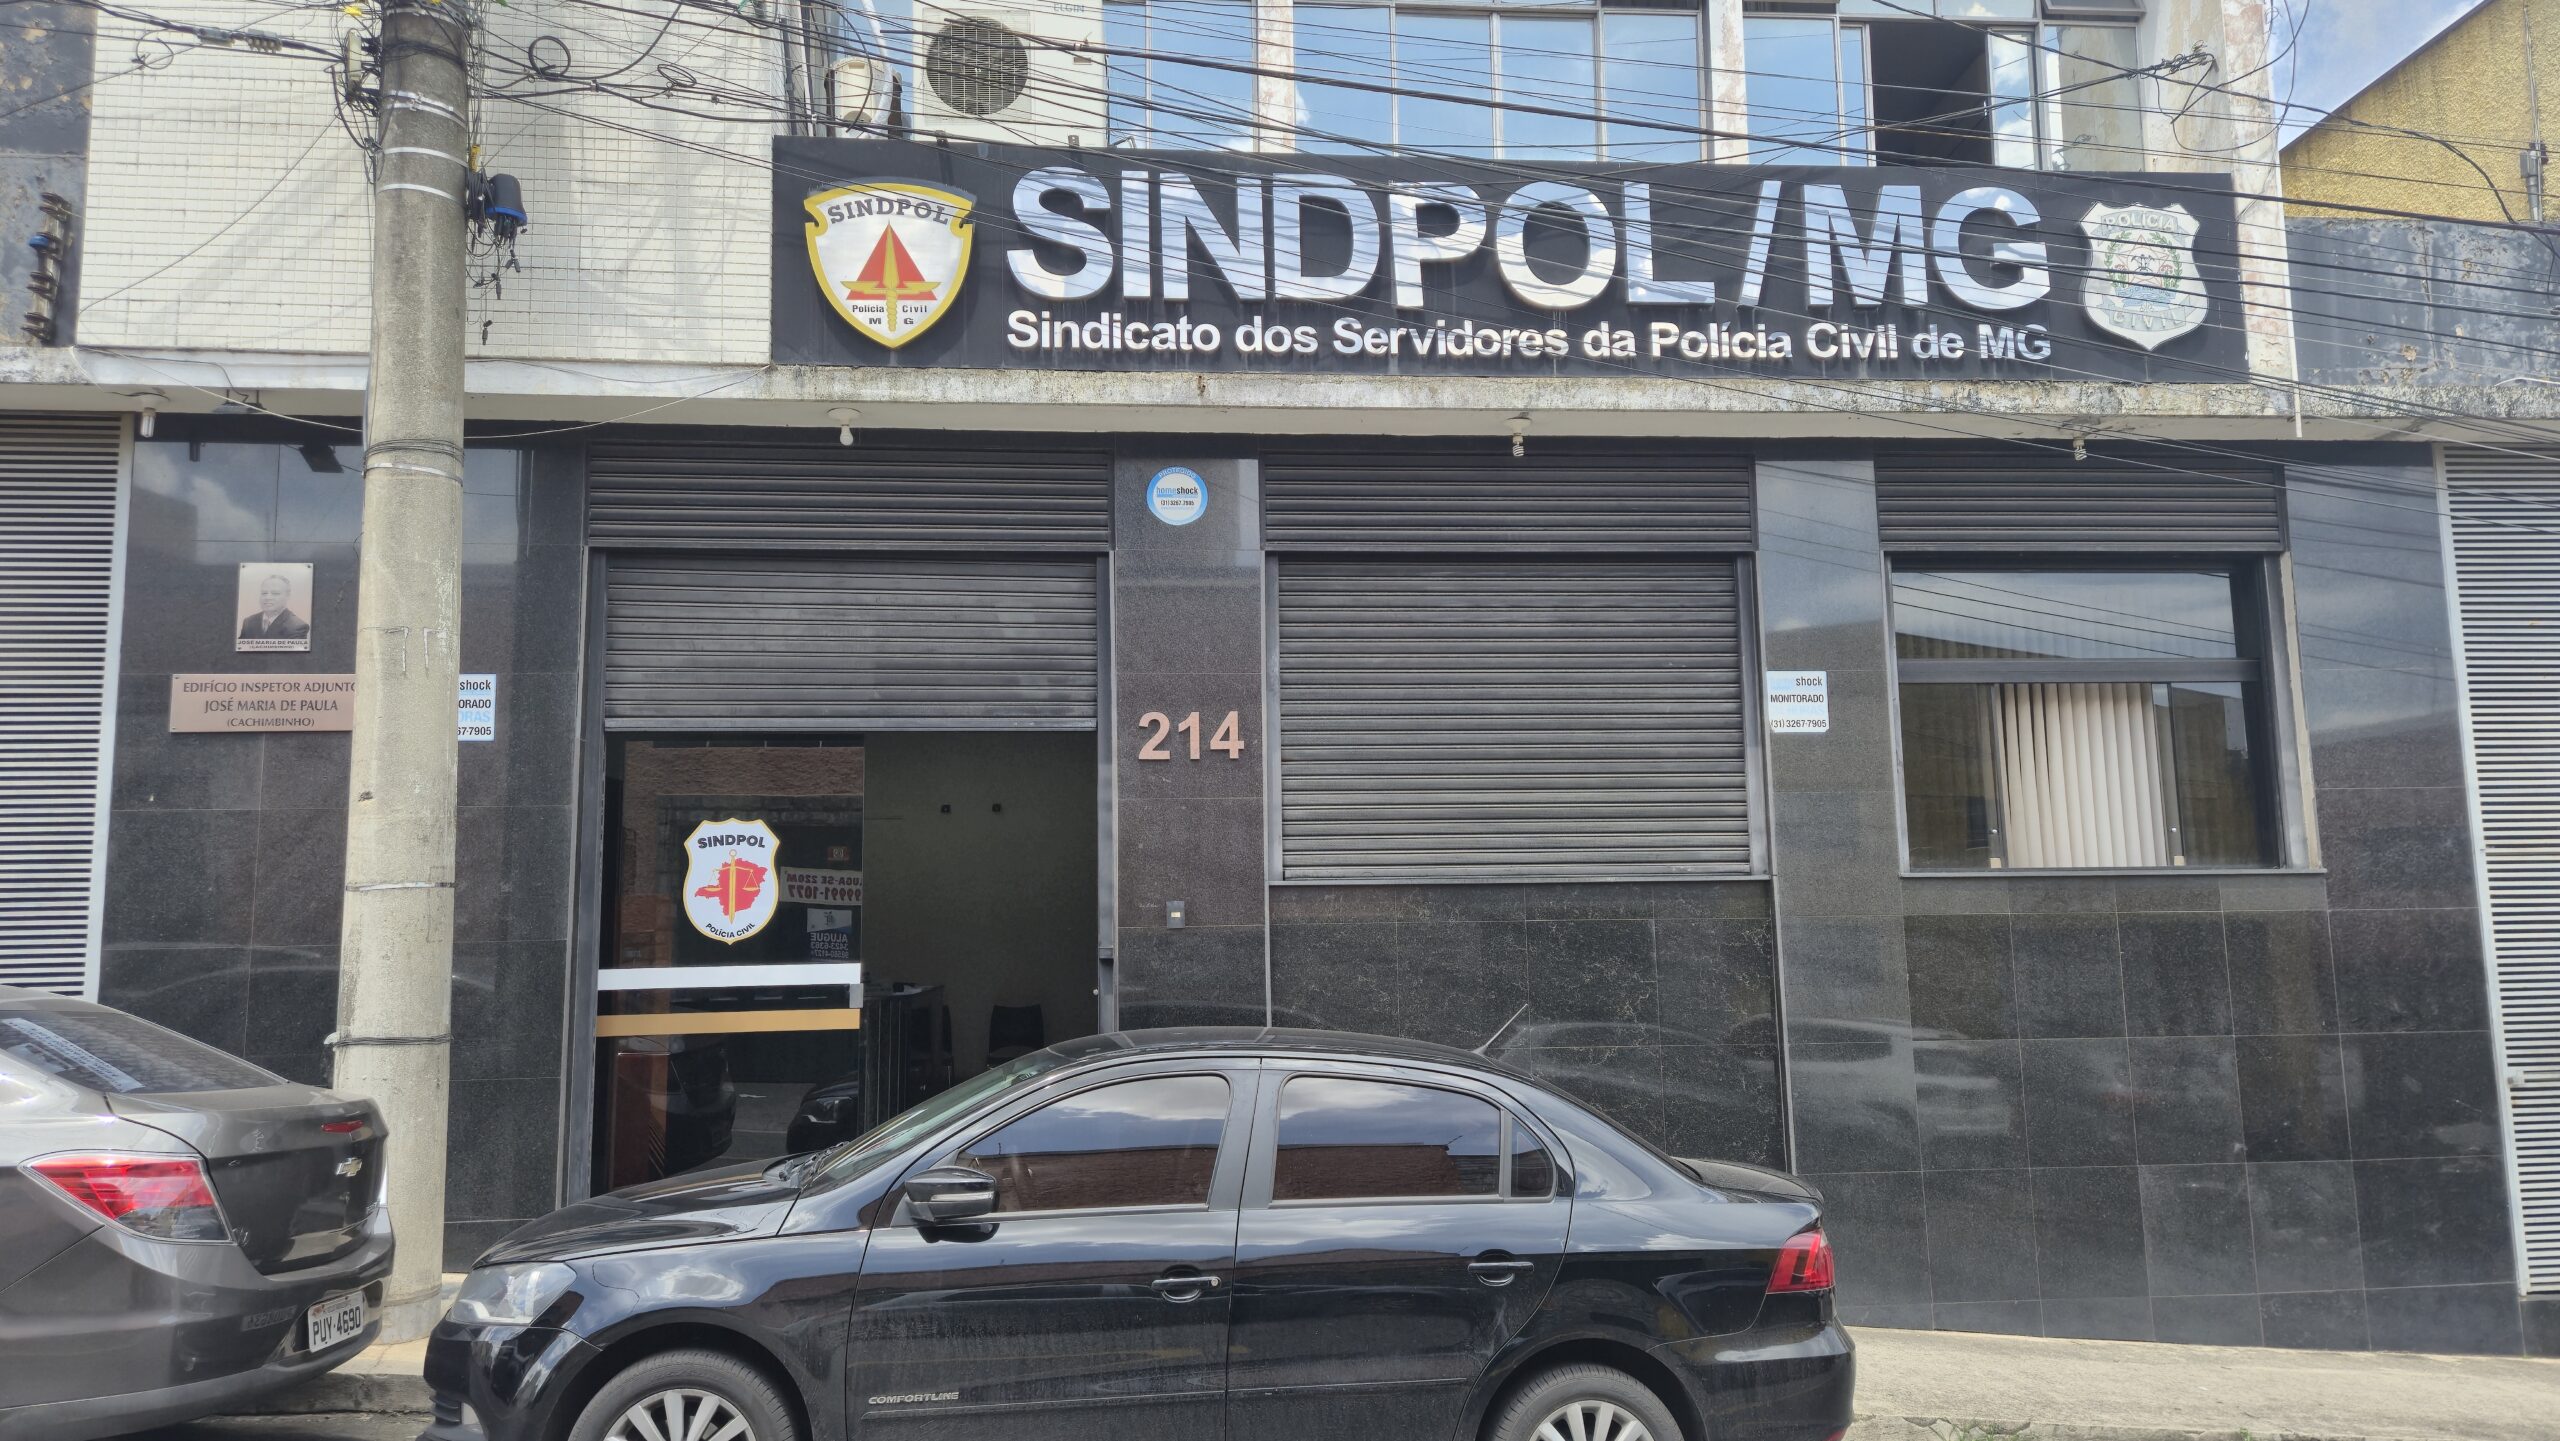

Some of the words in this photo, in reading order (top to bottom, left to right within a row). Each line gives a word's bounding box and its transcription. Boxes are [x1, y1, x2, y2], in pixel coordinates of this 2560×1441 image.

[827, 197, 949, 225] SINDPOL
[902, 304, 928, 313] Civil
[2113, 311, 2182, 330] CIVIL
[1006, 309, 1221, 352] Sindicato
[1235, 315, 1319, 353] dos
[1333, 316, 1570, 357] Servidores
[1583, 321, 1636, 358] da
[1650, 321, 1794, 359] Polícia
[1806, 322, 1898, 359] Civil
[1912, 324, 1966, 359] de
[1977, 323, 2052, 361] MG
[183, 680, 238, 693] EDIFÍCIO
[241, 682, 301, 693] INSPETOR
[205, 696, 234, 713] JOSÉ
[237, 699, 277, 711] MARIA
[280, 700, 296, 711] DE
[300, 700, 338, 711] PAULA
[458, 699, 492, 709] ORADO
[1770, 694, 1825, 703] MONITORADO
[227, 717, 315, 728] (CACHIMBINHO)
[1770, 719, 1785, 728] (31)
[1138, 710, 1245, 760] 214
[697, 834, 766, 849] SINDPOL
[705, 922, 736, 939] POLÍCIA
[736, 922, 756, 937] CIVIL
[868, 1391, 960, 1405] COMFORTLINE
